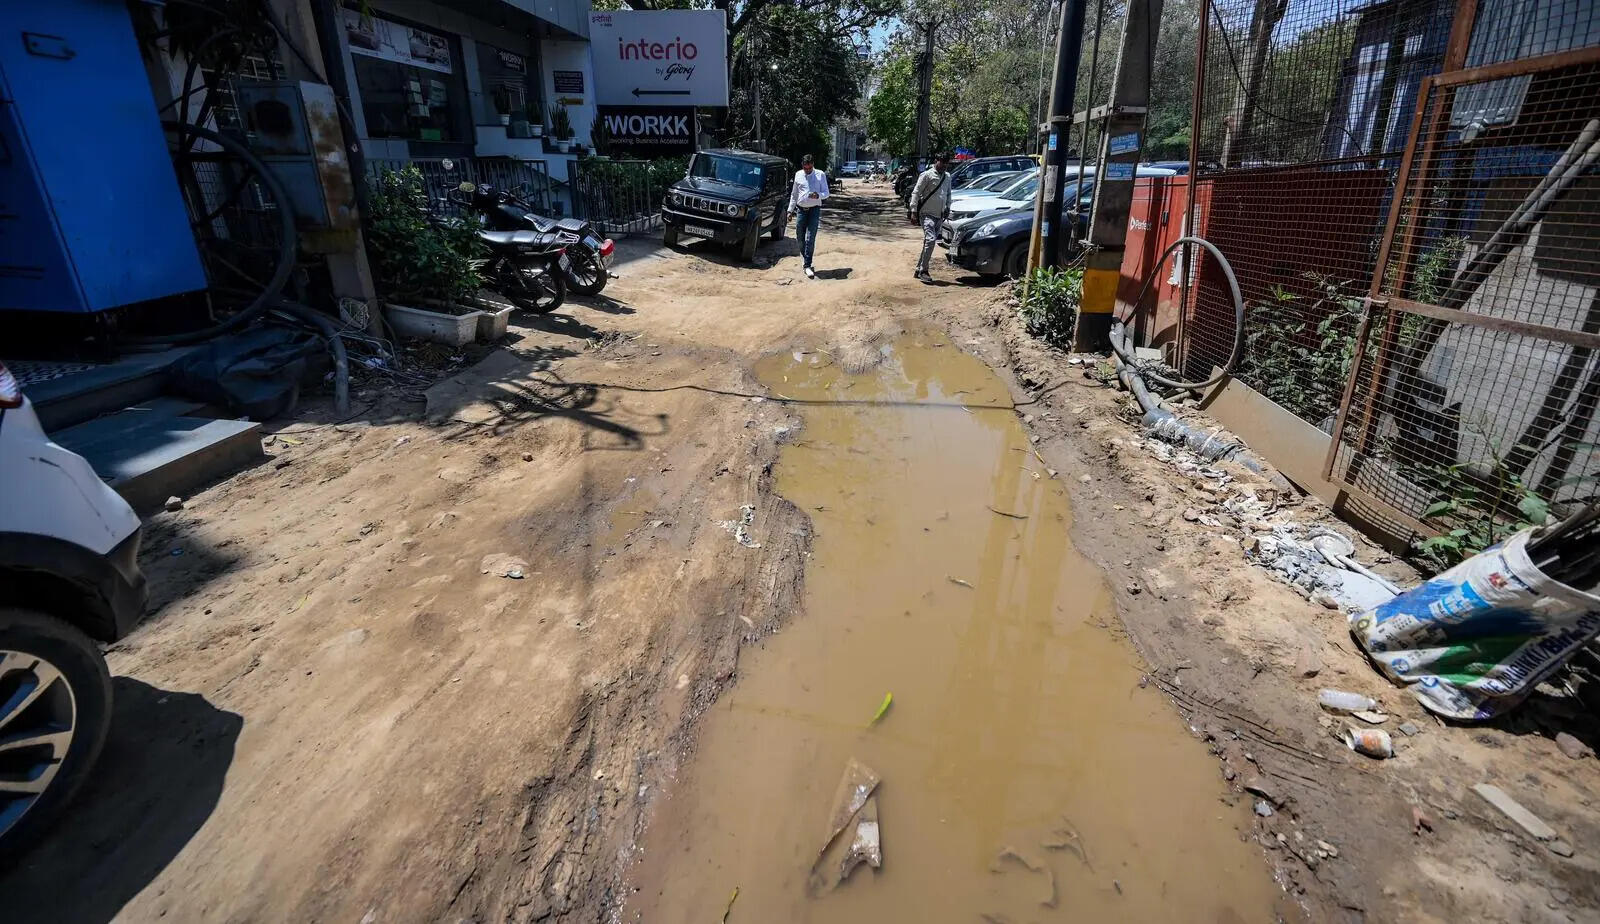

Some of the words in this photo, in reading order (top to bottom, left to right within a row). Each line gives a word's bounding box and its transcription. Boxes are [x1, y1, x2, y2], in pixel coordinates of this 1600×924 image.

[618, 36, 698, 60] interio
[656, 67, 663, 76] by
[664, 63, 696, 81] Godrej
[1135, 219, 1152, 230] Perfect
